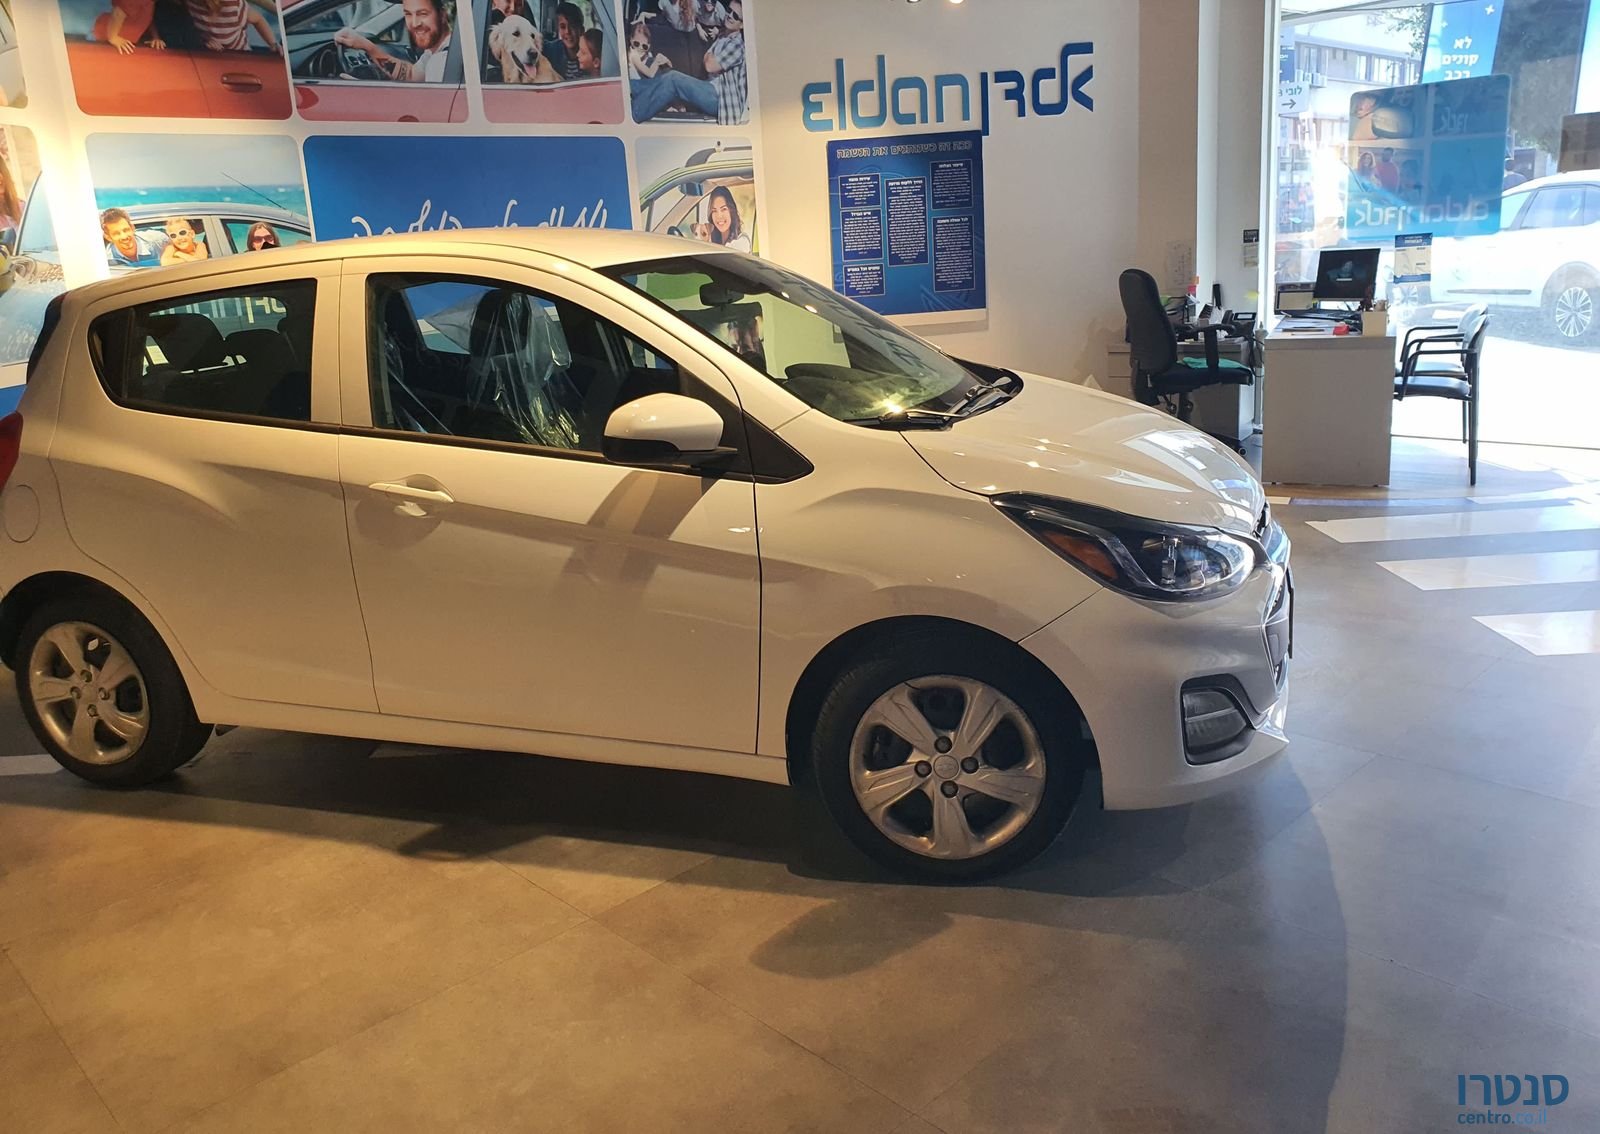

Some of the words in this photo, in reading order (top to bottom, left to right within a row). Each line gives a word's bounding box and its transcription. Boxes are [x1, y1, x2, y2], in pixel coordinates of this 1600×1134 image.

[1453, 35, 1473, 50] לא
[1442, 53, 1479, 67] קונים
[1444, 69, 1471, 81] רכב
[802, 54, 971, 133] eldan
[1285, 84, 1303, 96] לובי
[836, 147, 871, 159] הנשמה
[872, 146, 888, 156] את
